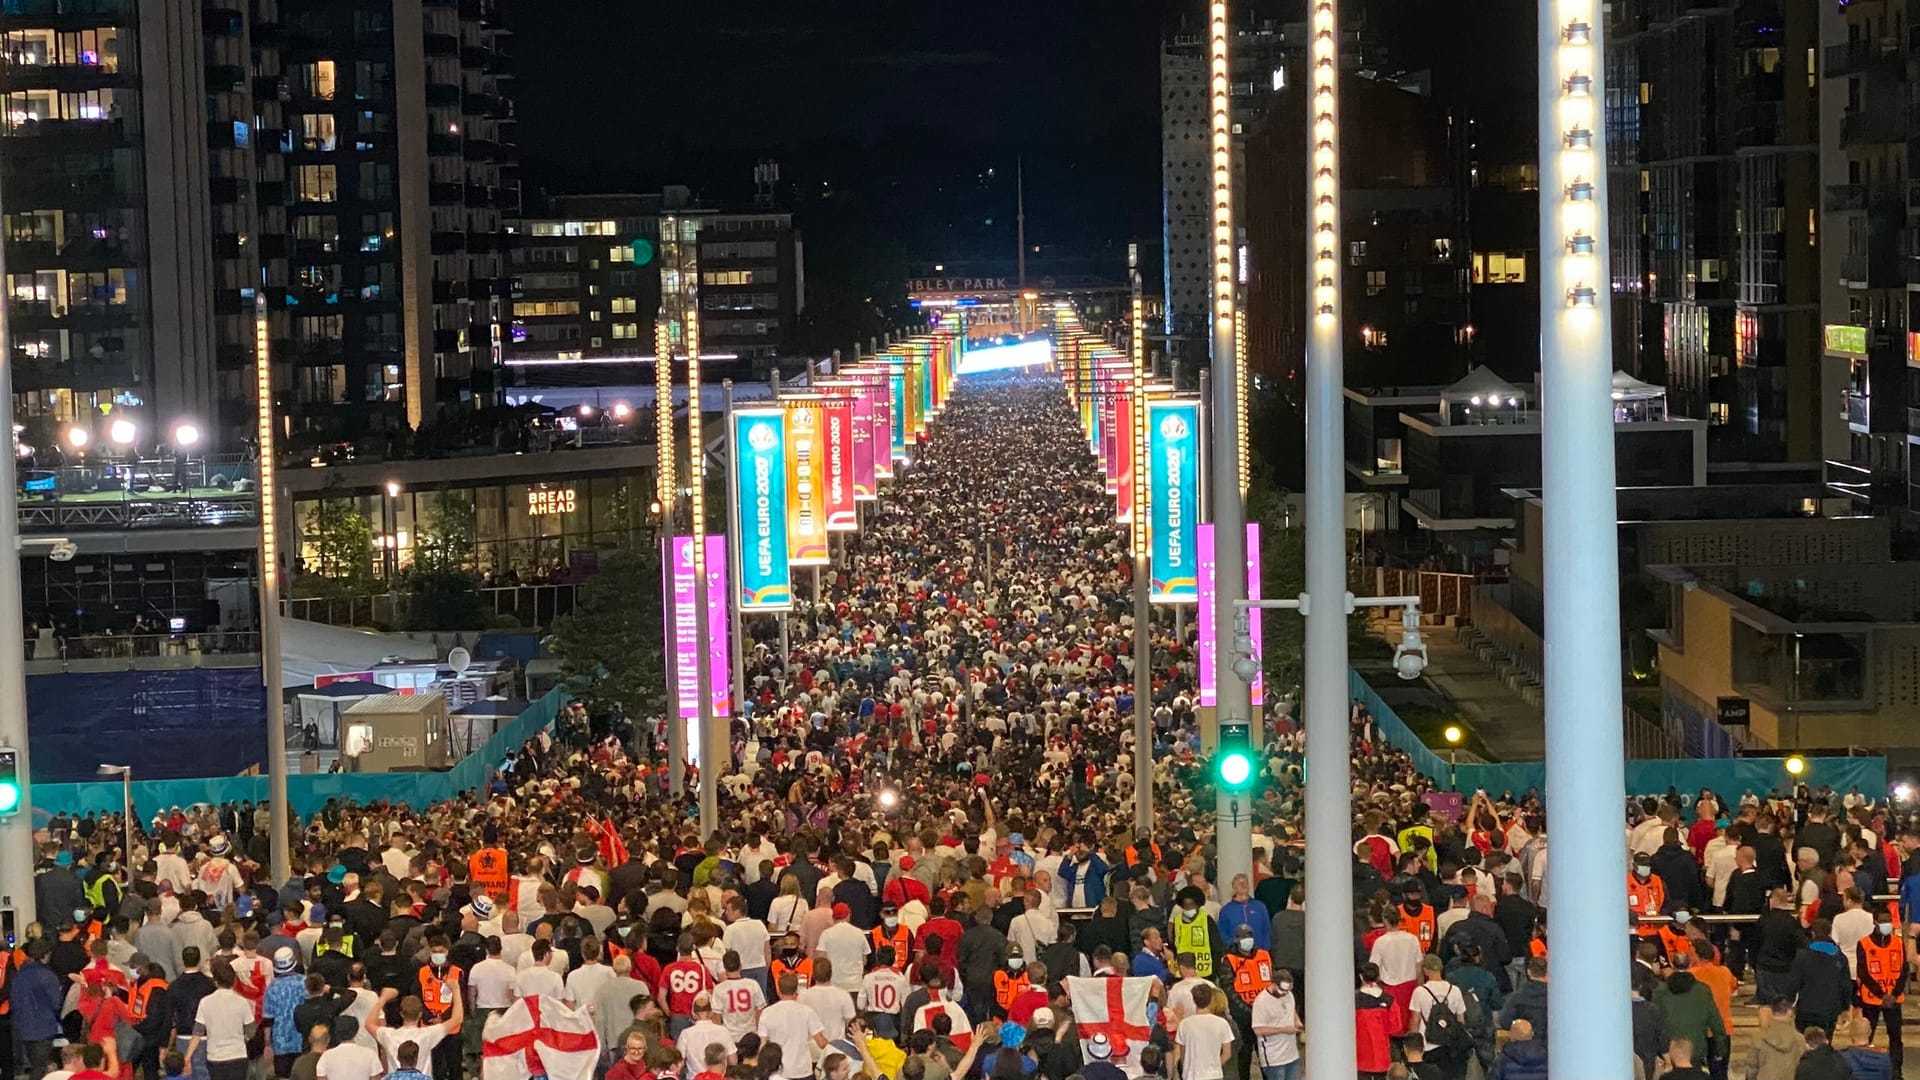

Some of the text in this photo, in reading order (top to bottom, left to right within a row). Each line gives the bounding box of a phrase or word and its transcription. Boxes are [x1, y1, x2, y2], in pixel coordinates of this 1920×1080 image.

[964, 278, 1006, 289] PARK
[830, 416, 843, 505] UEFA EURO 2020
[528, 489, 576, 504] BREAD
[528, 501, 576, 515] AHEAD
[1167, 446, 1182, 568] UEFA EURO 2020
[755, 455, 772, 577] UEFA EURO 2020
[669, 969, 701, 993] 66
[727, 988, 752, 1014] 19
[874, 984, 897, 1009] 10
